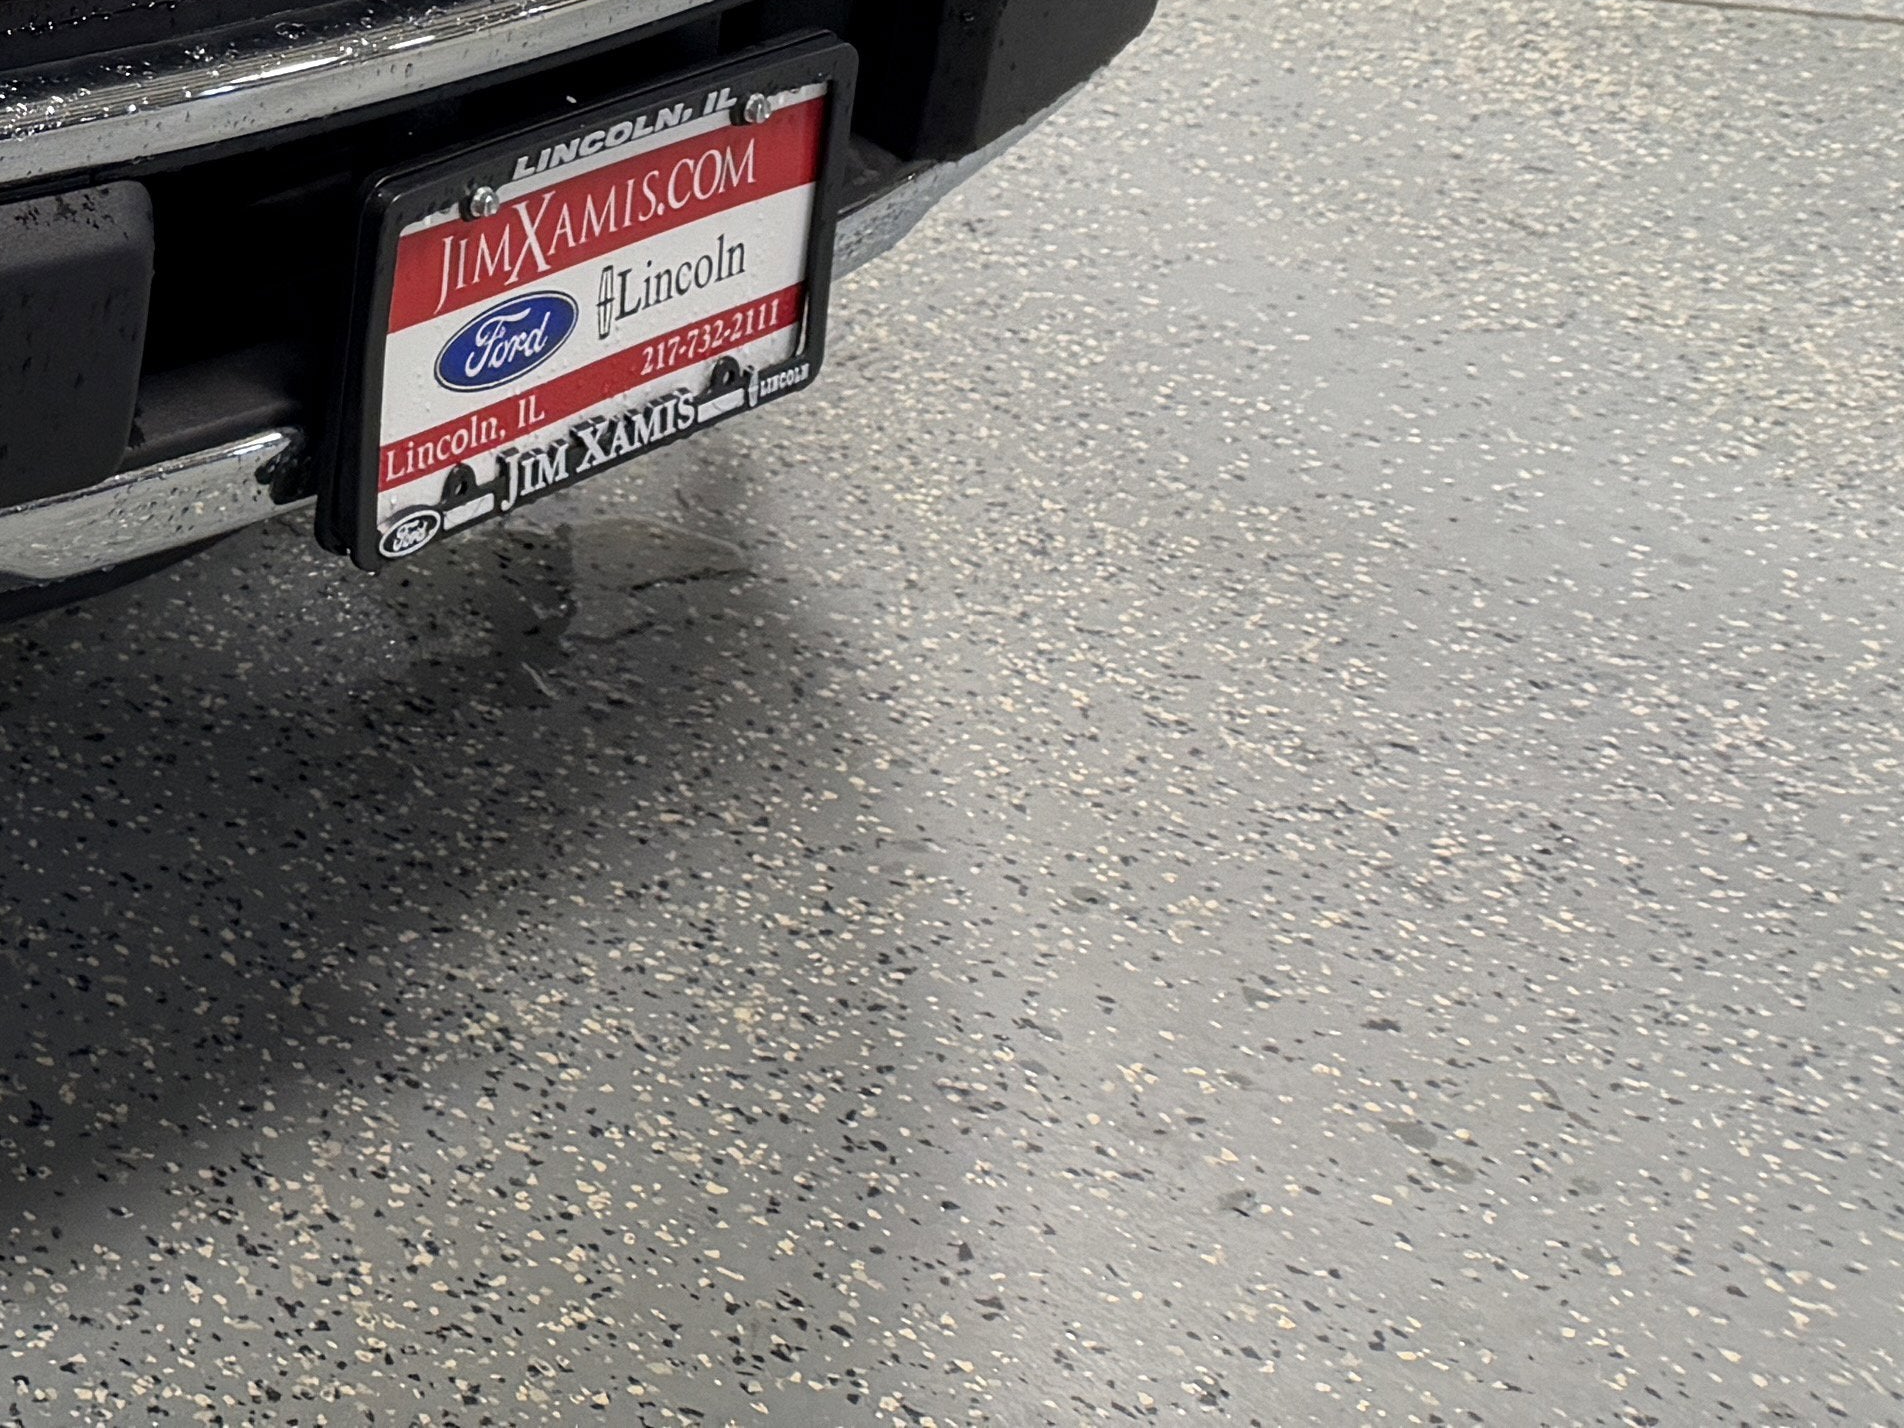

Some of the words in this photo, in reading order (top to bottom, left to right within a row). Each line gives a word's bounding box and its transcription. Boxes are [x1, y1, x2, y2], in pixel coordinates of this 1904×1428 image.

[512, 101, 693, 181] LINCOLN,
[703, 86, 738, 116] IL
[434, 138, 758, 313] JIMXAMIS.COM
[614, 234, 747, 322] Lincoln
[464, 308, 552, 378] Ford
[639, 298, 780, 376] 217-732-2111
[759, 363, 811, 398] LINCOLN
[385, 414, 506, 482] Lincoln,
[517, 394, 546, 429] IL
[498, 444, 569, 512] JIM
[576, 393, 696, 474] XAMIS
[393, 518, 430, 552] Ford
